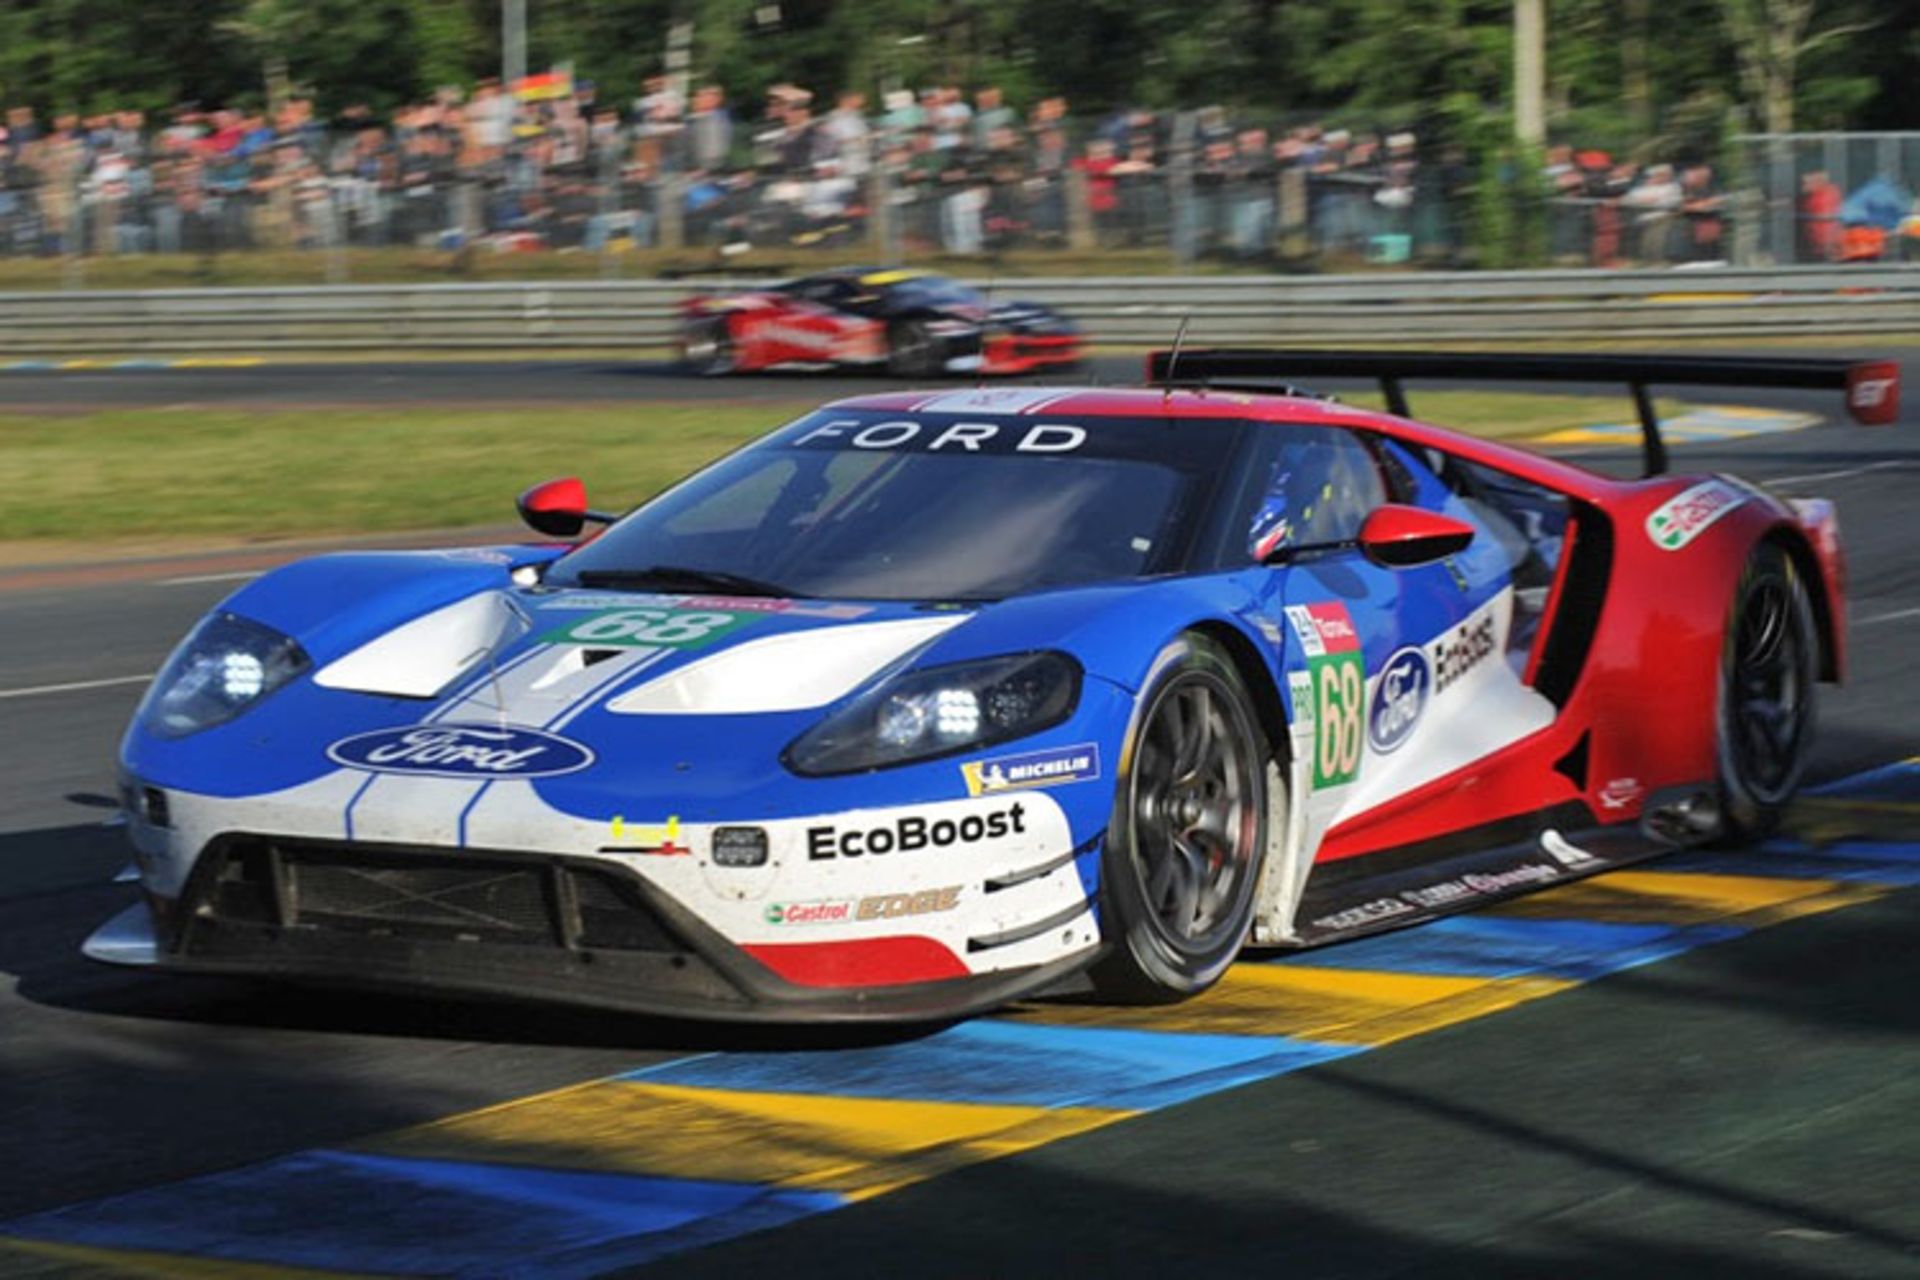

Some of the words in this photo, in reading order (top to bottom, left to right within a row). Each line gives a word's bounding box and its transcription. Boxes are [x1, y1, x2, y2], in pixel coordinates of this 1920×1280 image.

[793, 420, 1087, 451] FORD
[570, 611, 735, 642] 68
[1319, 661, 1361, 779] 68
[1378, 662, 1422, 738] Ford
[367, 728, 546, 771] Ford
[1009, 757, 1089, 779] MICHELIN
[808, 802, 1025, 860] EcoBoost
[787, 902, 849, 923] Castrol
[856, 886, 963, 920] EDGE
